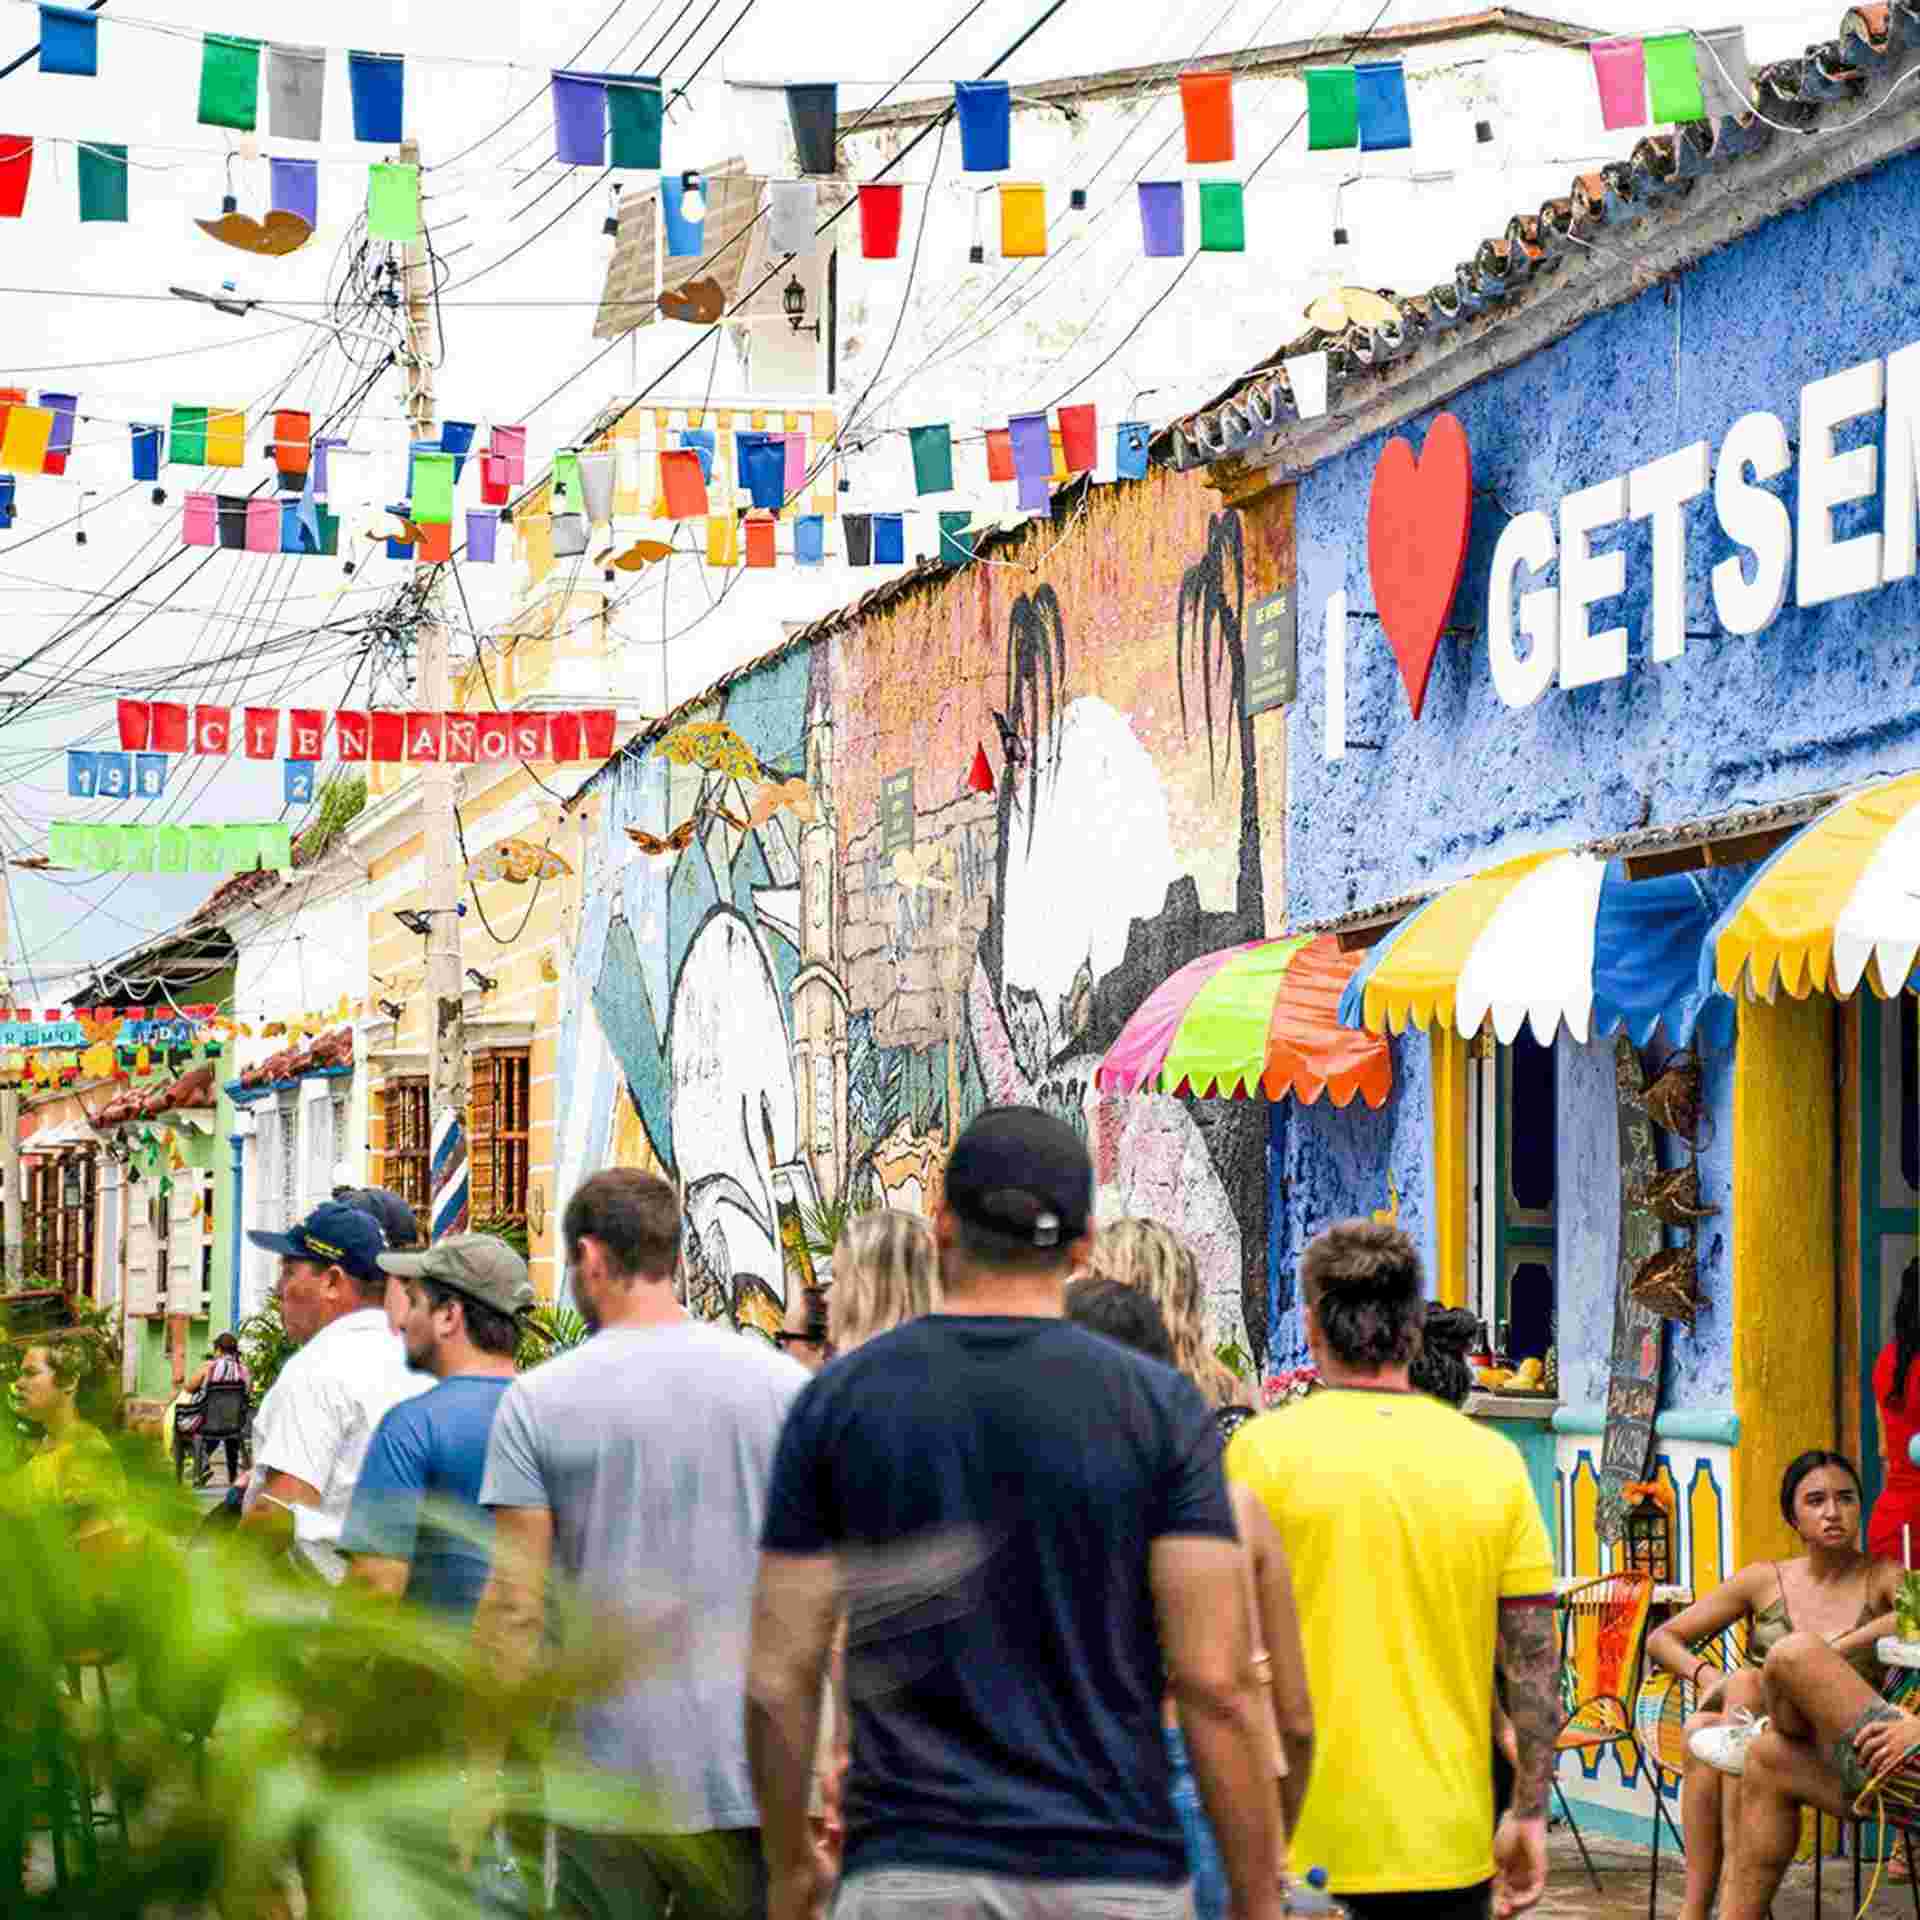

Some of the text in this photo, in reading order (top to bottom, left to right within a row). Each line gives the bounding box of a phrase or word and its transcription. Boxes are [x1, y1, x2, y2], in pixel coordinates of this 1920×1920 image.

[1325, 590, 1347, 759] I
[201, 720, 538, 758] CIEN AÑOS
